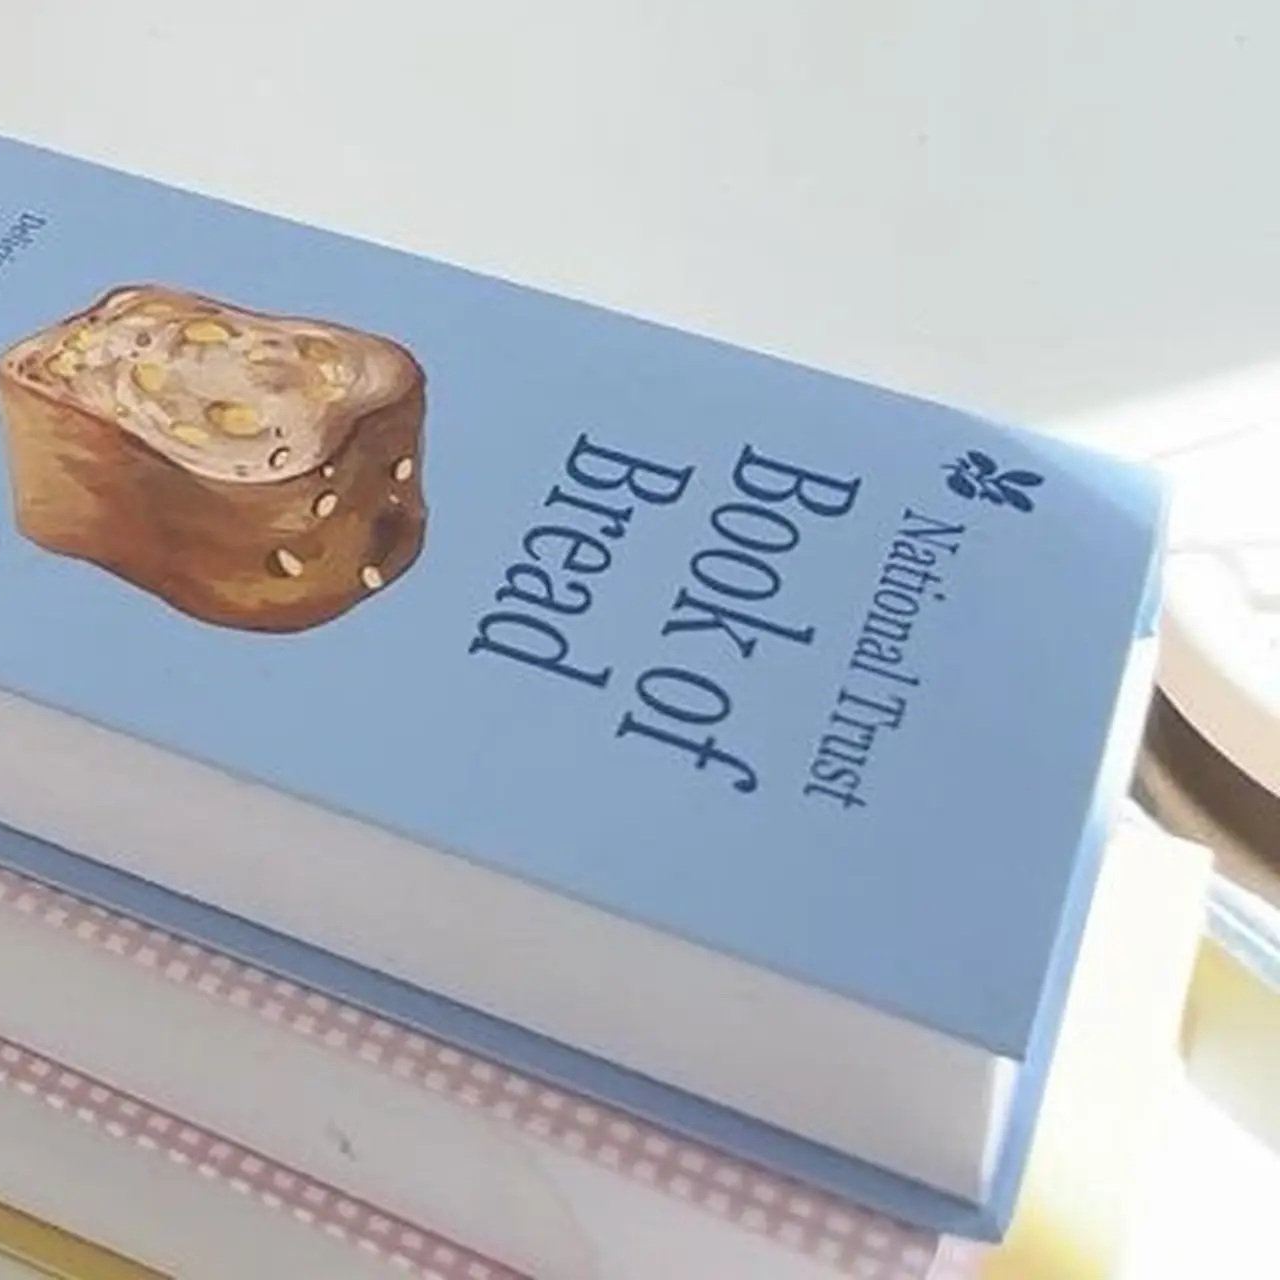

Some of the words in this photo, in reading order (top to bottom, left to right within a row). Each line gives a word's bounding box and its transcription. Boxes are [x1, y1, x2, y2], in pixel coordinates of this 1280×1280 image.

[468, 433, 695, 688] Bread
[661, 444, 862, 659] Book
[849, 507, 967, 687] National
[616, 666, 758, 793] of
[804, 690, 907, 809] Trust
